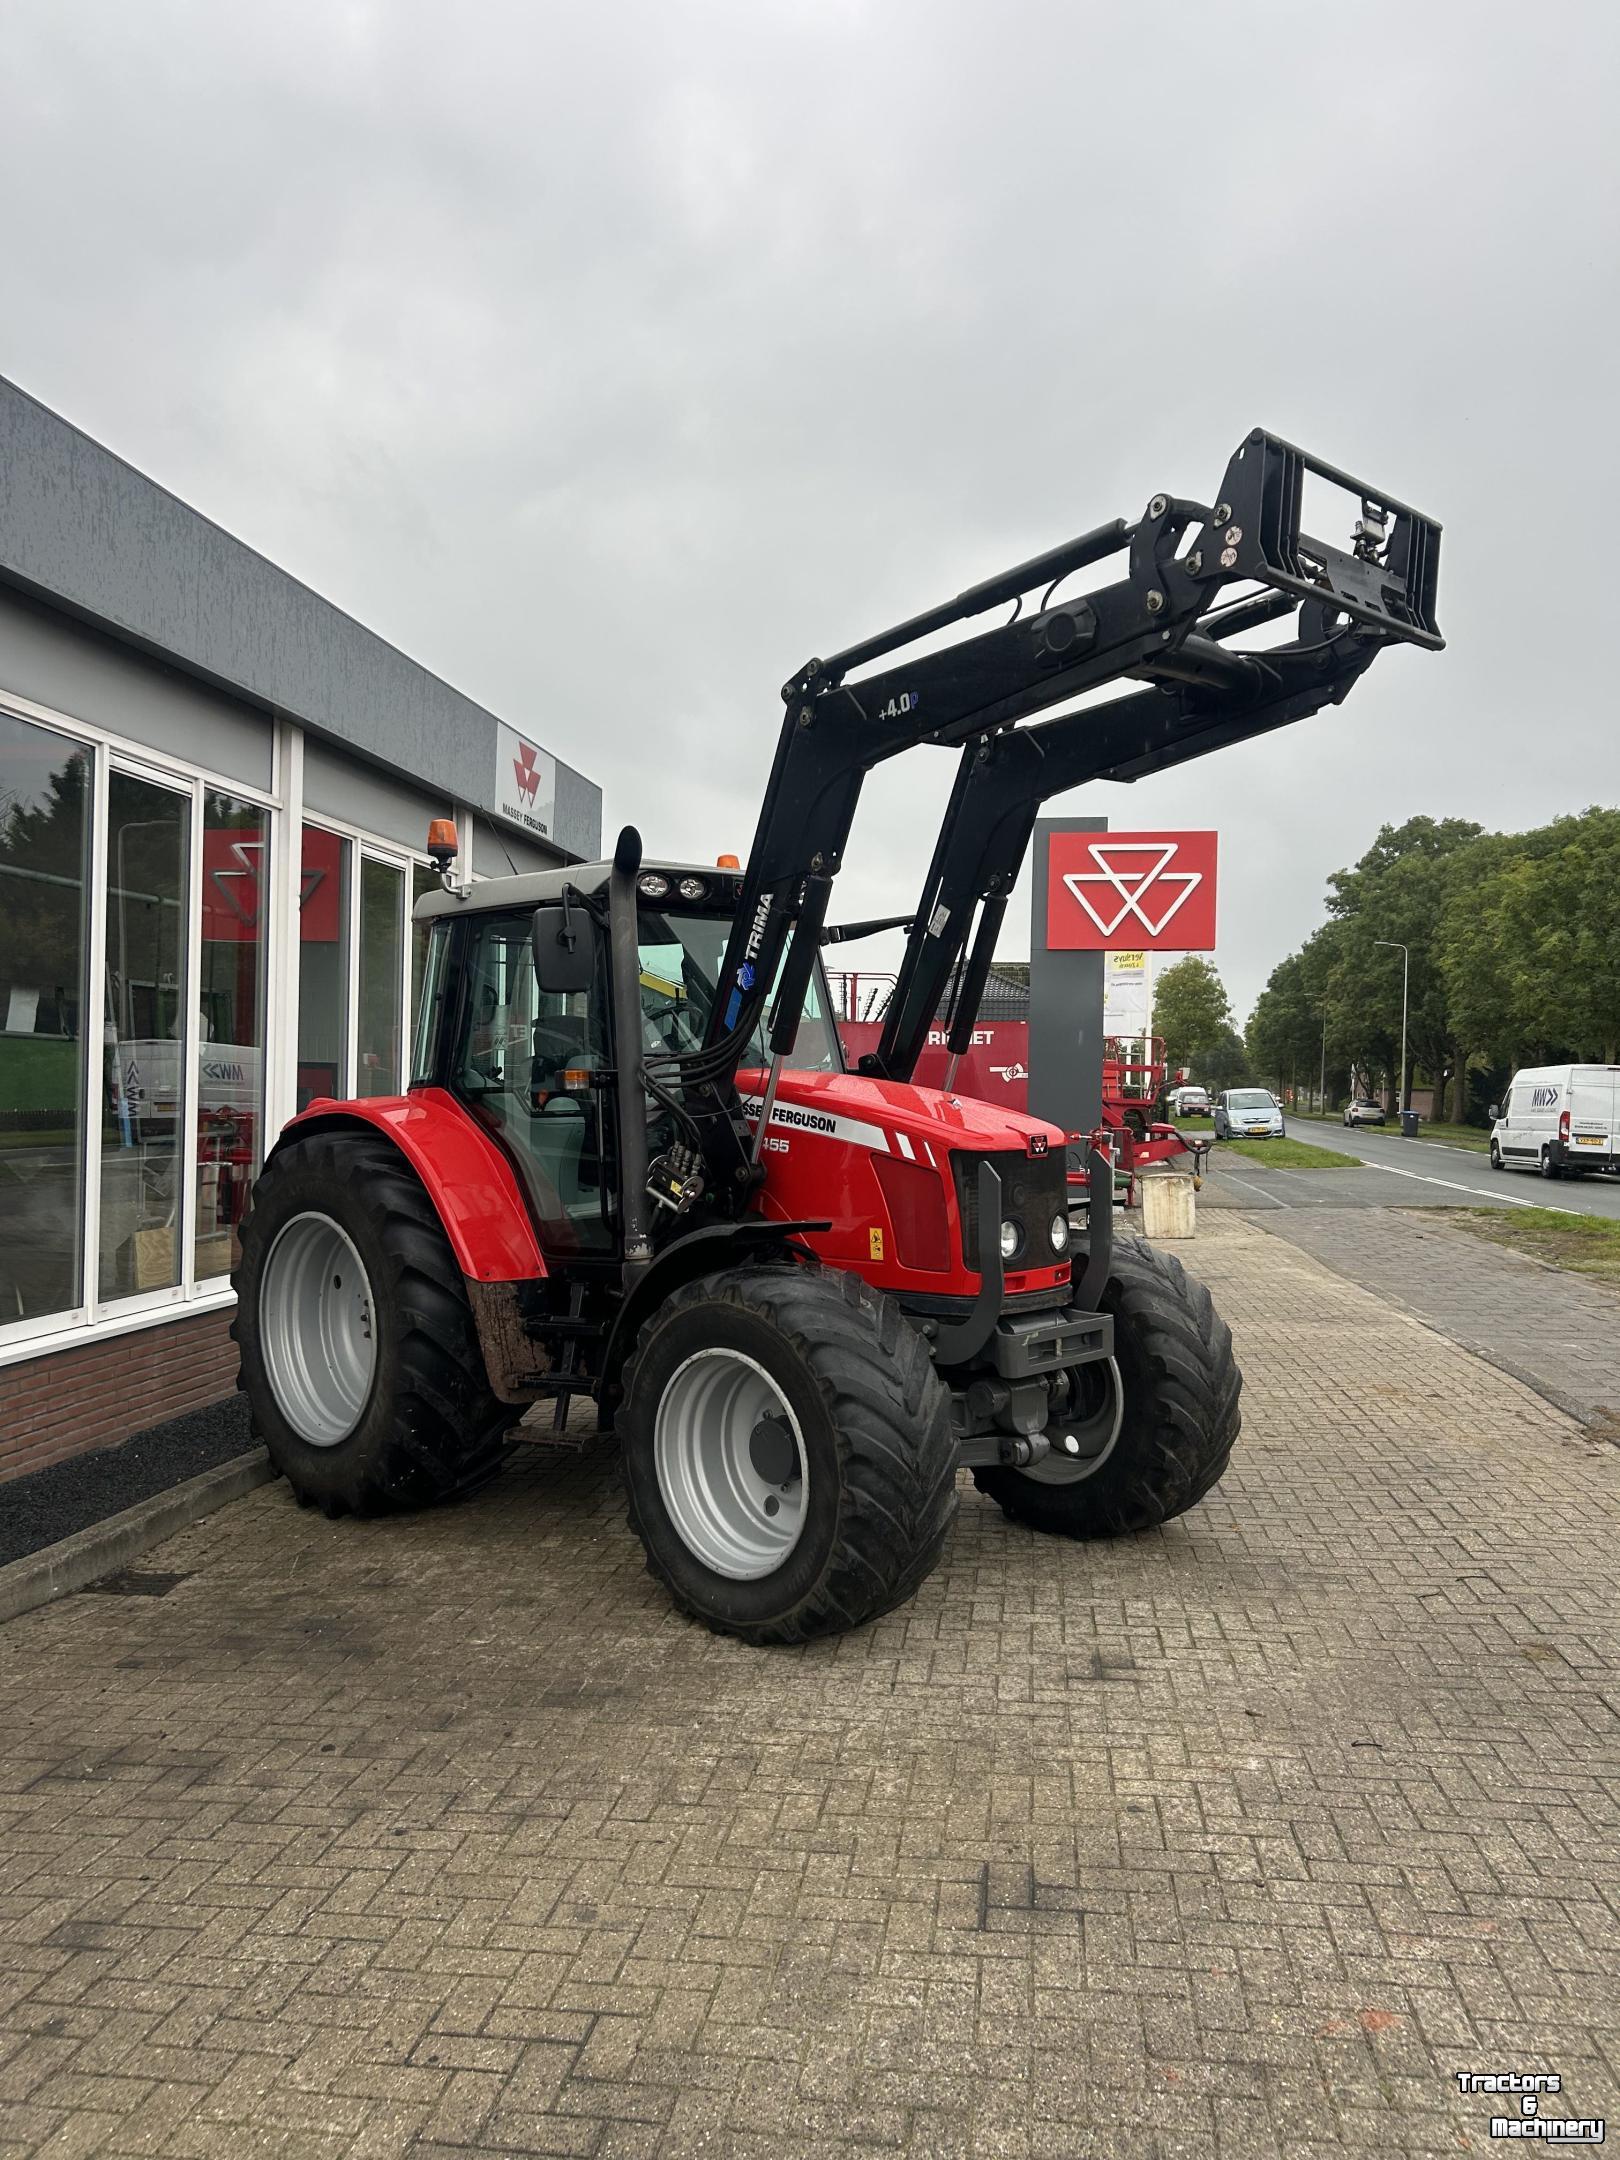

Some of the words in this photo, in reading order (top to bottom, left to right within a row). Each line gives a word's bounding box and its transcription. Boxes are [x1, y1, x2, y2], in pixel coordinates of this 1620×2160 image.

[502, 802, 523, 821] MASSEY
[524, 813, 548, 835] FERGUSON
[744, 893, 774, 960] TRIMA
[772, 1107, 837, 1133] FERGUSON
[763, 1137, 790, 1153] 455
